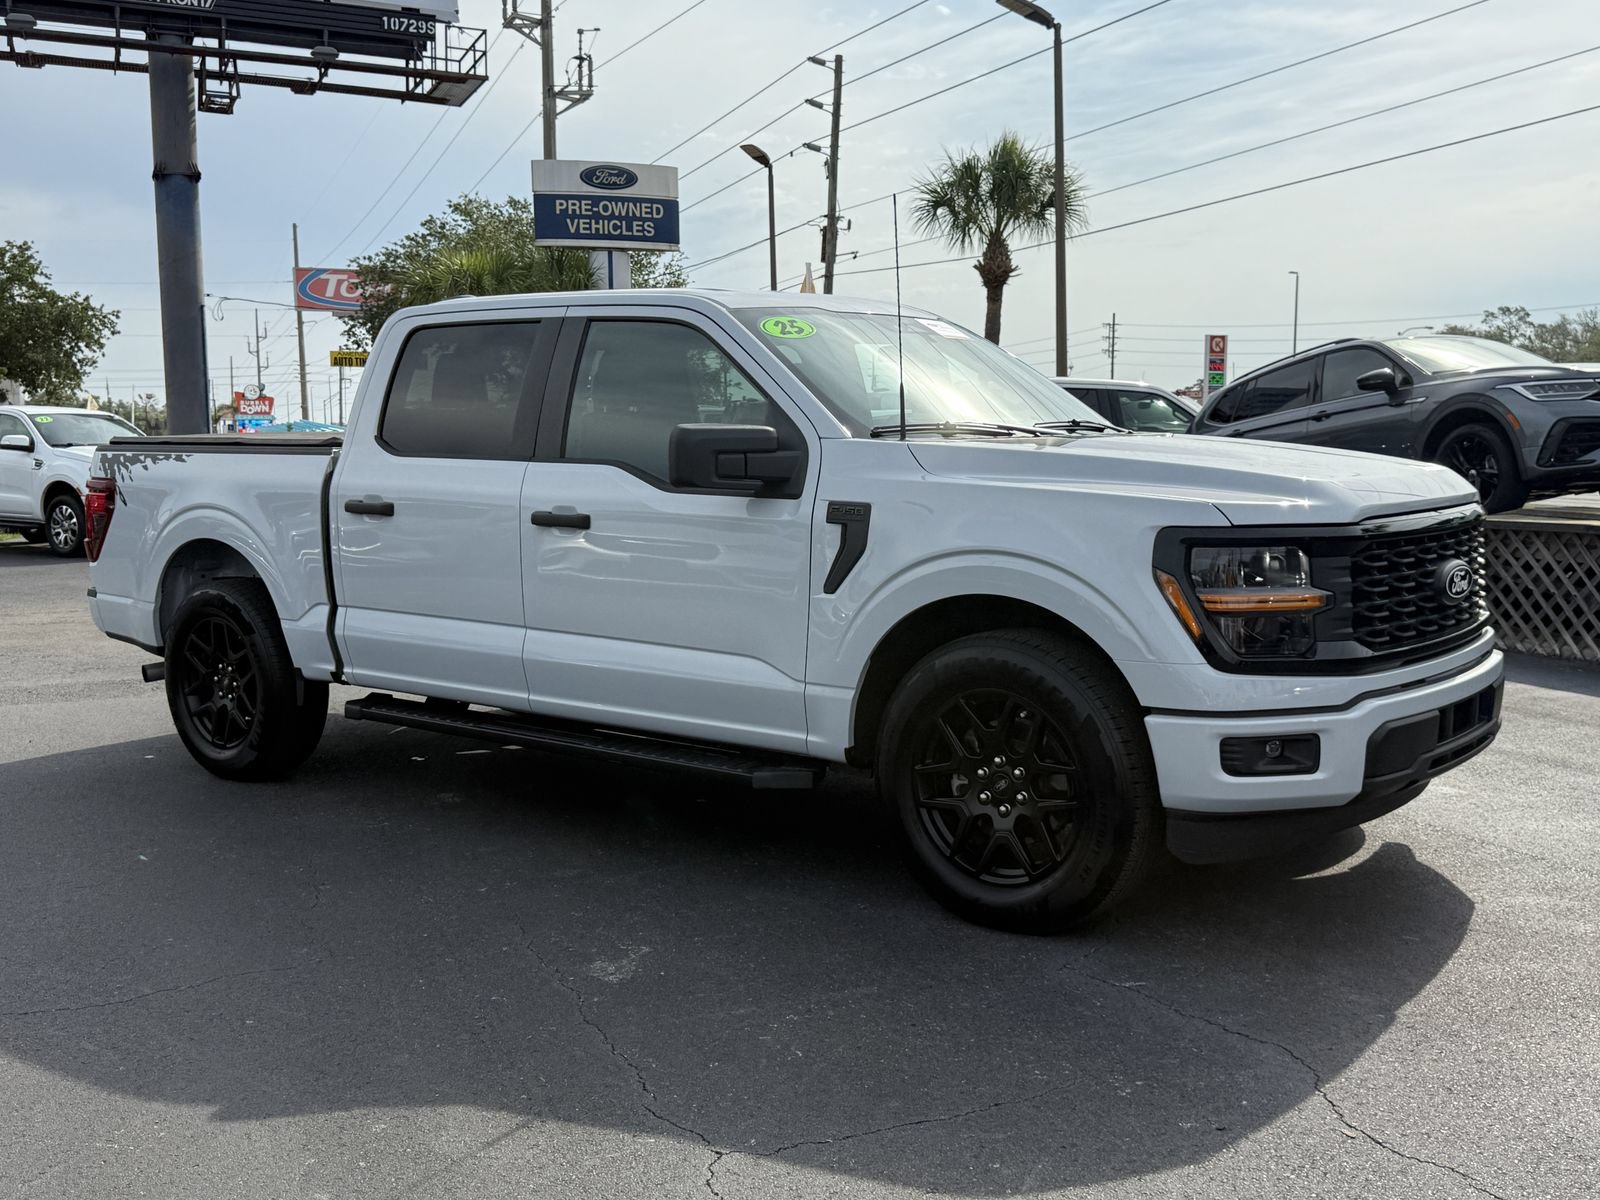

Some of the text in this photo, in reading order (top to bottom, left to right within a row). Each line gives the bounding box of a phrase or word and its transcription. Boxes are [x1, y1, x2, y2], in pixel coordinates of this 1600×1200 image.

[382, 16, 435, 35] 10729S
[592, 167, 628, 185] Ford
[555, 199, 664, 219] PRE-OWNED
[566, 218, 656, 237] VEHICLES
[774, 319, 805, 336] 25
[333, 356, 353, 367] AUTO
[239, 405, 270, 414] DOWN
[1451, 570, 1470, 594] Ford
